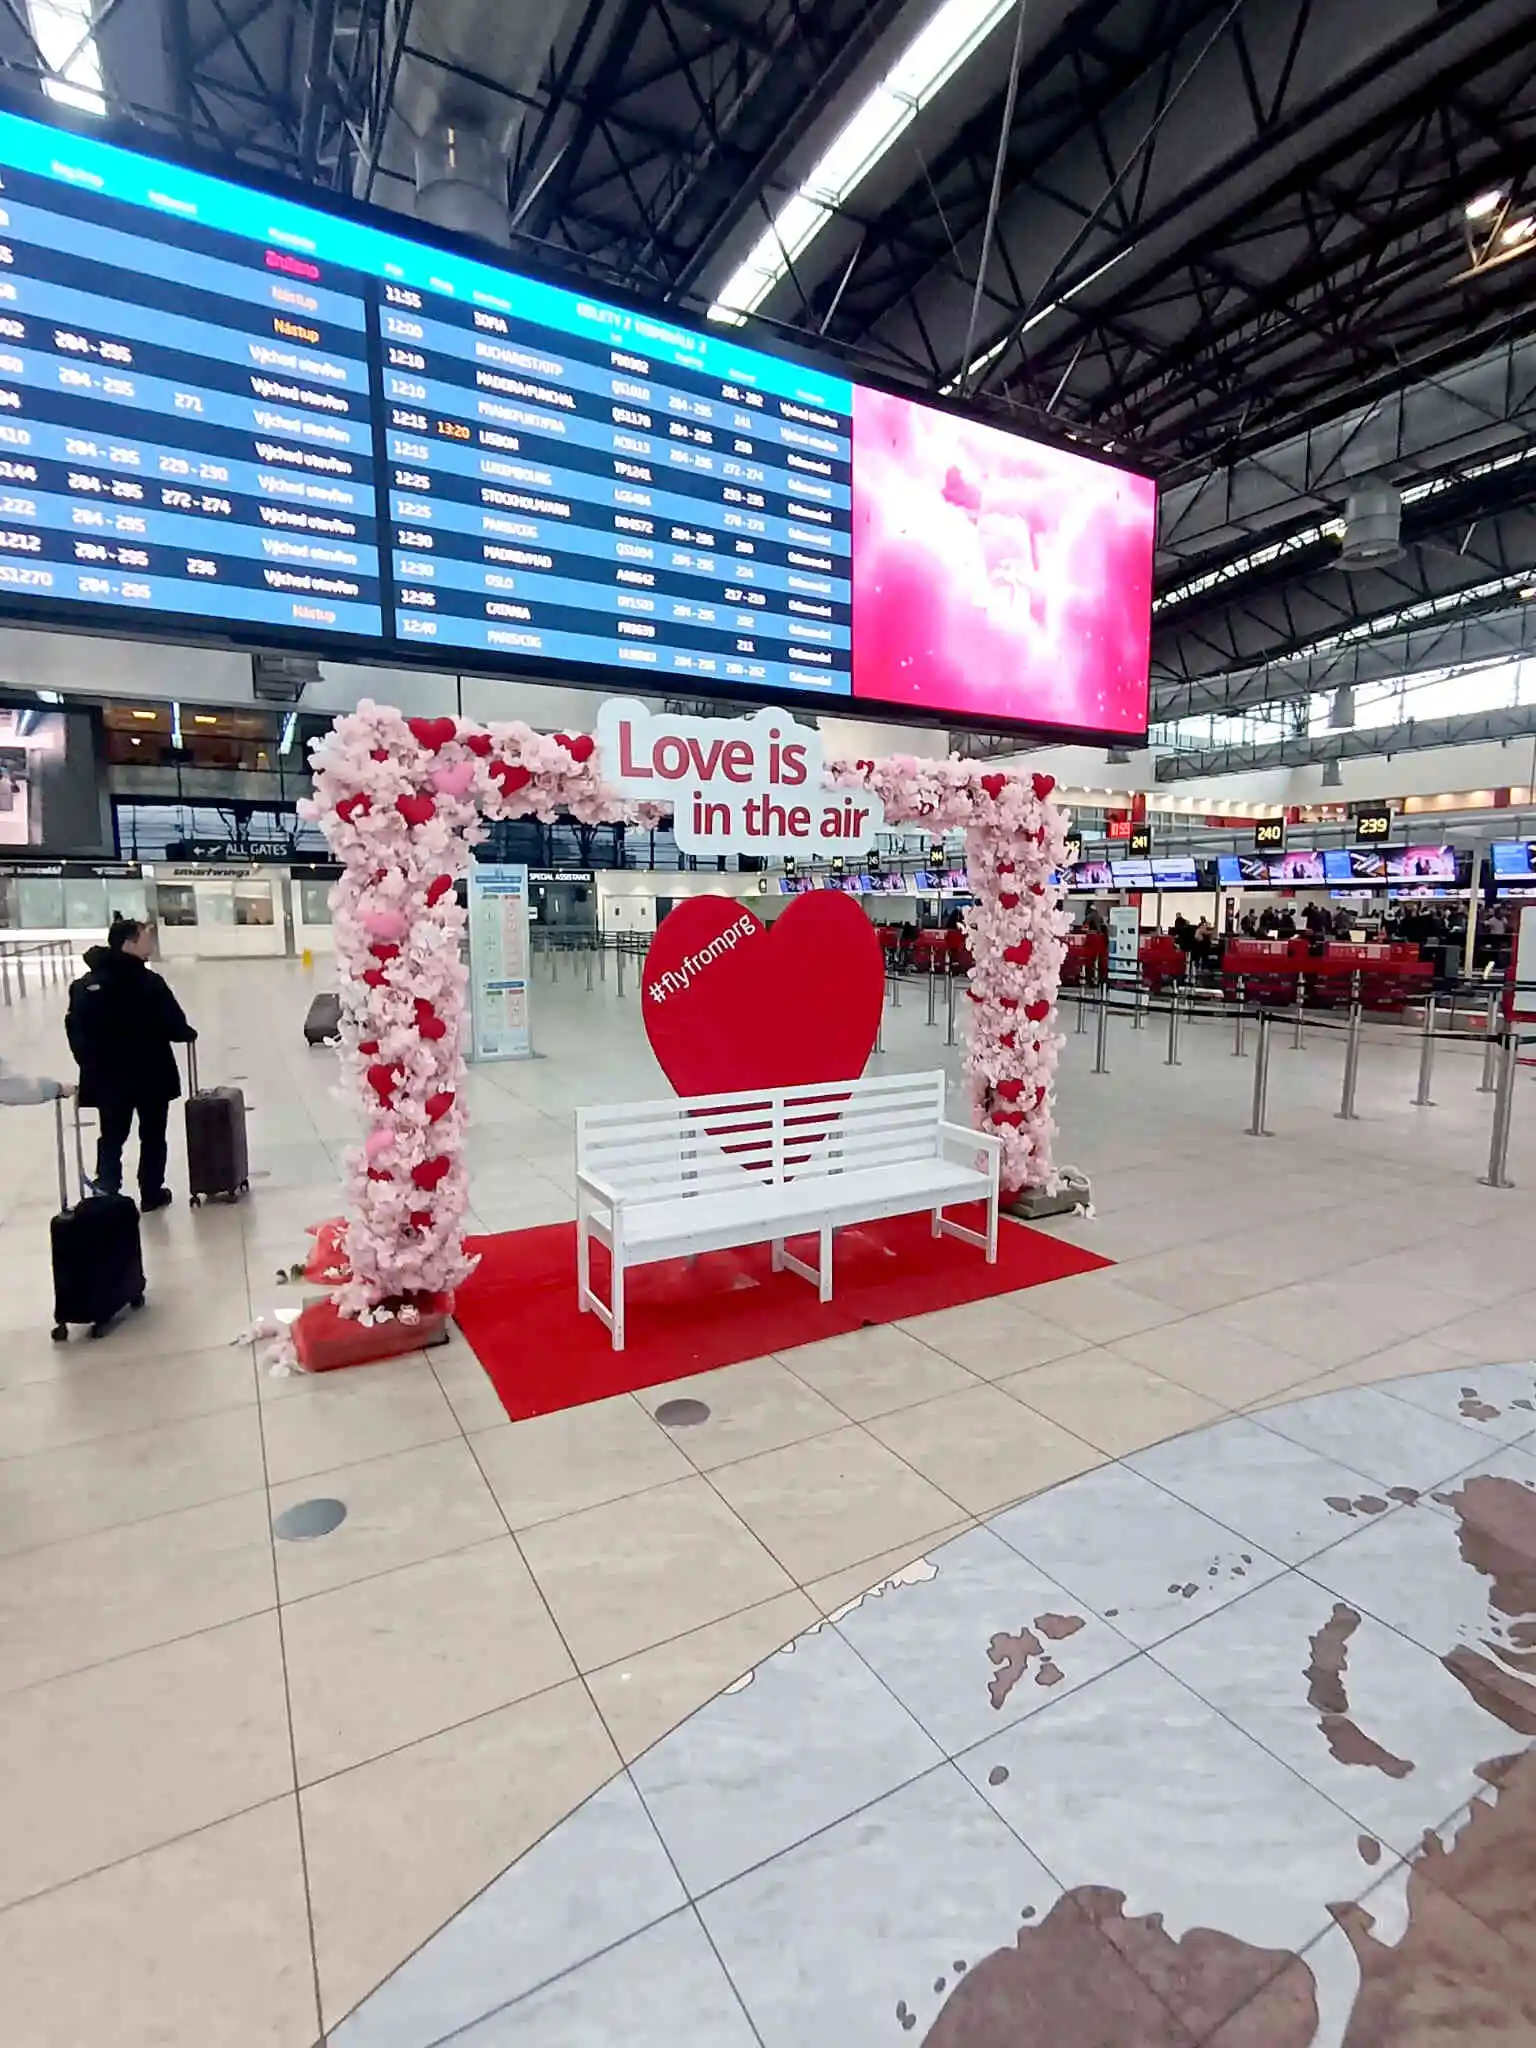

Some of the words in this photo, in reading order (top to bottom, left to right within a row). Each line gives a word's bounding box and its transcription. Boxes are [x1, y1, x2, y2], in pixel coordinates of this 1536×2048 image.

[437, 421, 470, 440] 13:20
[618, 721, 754, 783] Love
[768, 727, 808, 786] is
[692, 790, 731, 836] in
[742, 793, 811, 837] the
[819, 797, 870, 839] air
[1257, 825, 1281, 841] 240
[1358, 817, 1388, 835] 239
[225, 844, 247, 856] ALL
[250, 844, 287, 857] GATES
[1131, 835, 1148, 849] 241
[529, 873, 554, 881] SPECIAL
[555, 873, 592, 881] ASSISTANCE
[648, 913, 757, 1004] #flyfromprg
